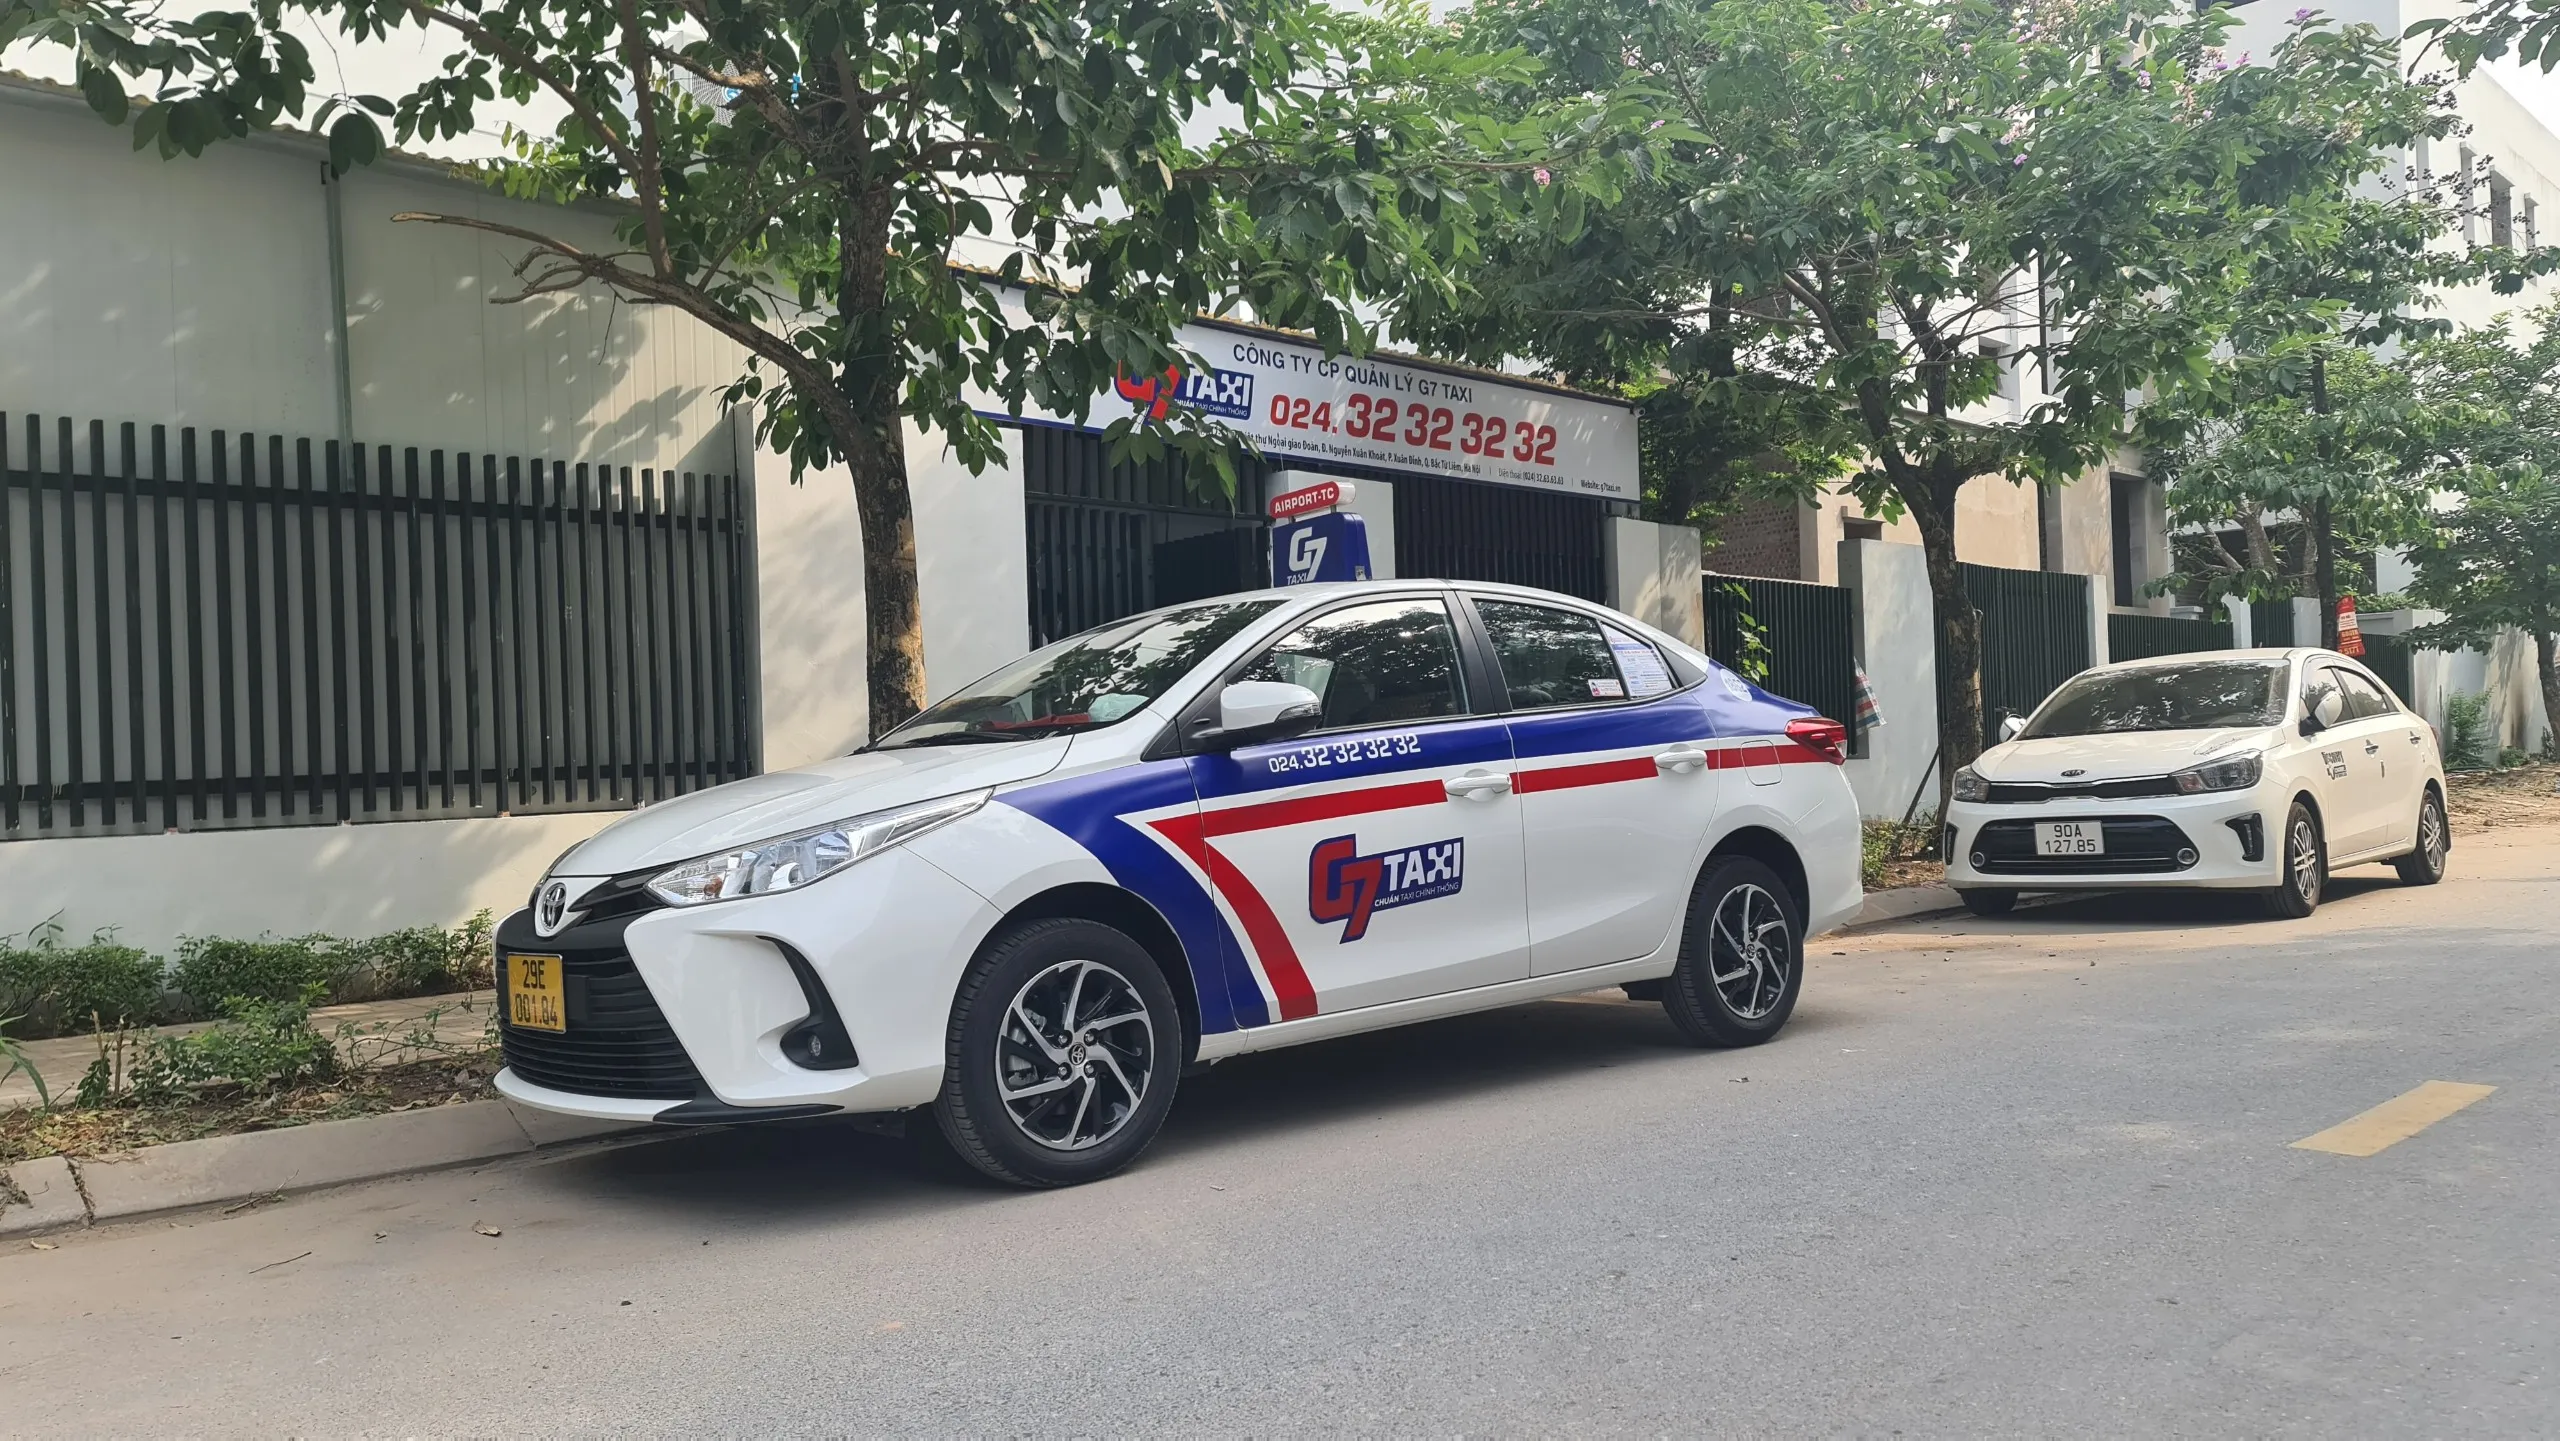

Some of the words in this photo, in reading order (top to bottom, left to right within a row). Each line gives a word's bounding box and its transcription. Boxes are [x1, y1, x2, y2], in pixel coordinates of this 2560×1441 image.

[1184, 367, 1251, 407] TAXI
[1233, 342, 1284, 370] CÔNG
[1290, 354, 1312, 374] TY
[1318, 359, 1340, 379] CP
[1345, 363, 1390, 389] QUẢN
[1395, 371, 1412, 392] LÝ
[1418, 378, 1438, 397] G7
[1442, 383, 1473, 403] TAXI
[1269, 394, 1338, 434] 024.
[1345, 393, 1398, 443] 32
[1404, 402, 1454, 451] 32
[1460, 412, 1507, 459] 32
[1513, 421, 1557, 466] 32
[1288, 440, 1302, 450] giao
[1352, 447, 1367, 459] Xuân
[1394, 453, 1408, 464] Xuân
[1522, 471, 1536, 483] (024)
[1274, 487, 1335, 513] AIRPORT-TC
[1288, 526, 1328, 582] G7
[1332, 740, 1363, 763] 32
[1366, 736, 1392, 759] 32
[1395, 733, 1421, 755] 32
[2045, 839, 2096, 853] 127.85
[2053, 823, 2082, 838] 90A
[1310, 836, 1383, 942] G7
[1383, 842, 1461, 892] TAXI
[1400, 892, 1415, 901] TAXI
[1415, 886, 1436, 898] CHÍNH
[1437, 881, 1459, 893] THỐNG
[522, 959, 546, 990] 29E
[514, 993, 558, 1026] 001.84
